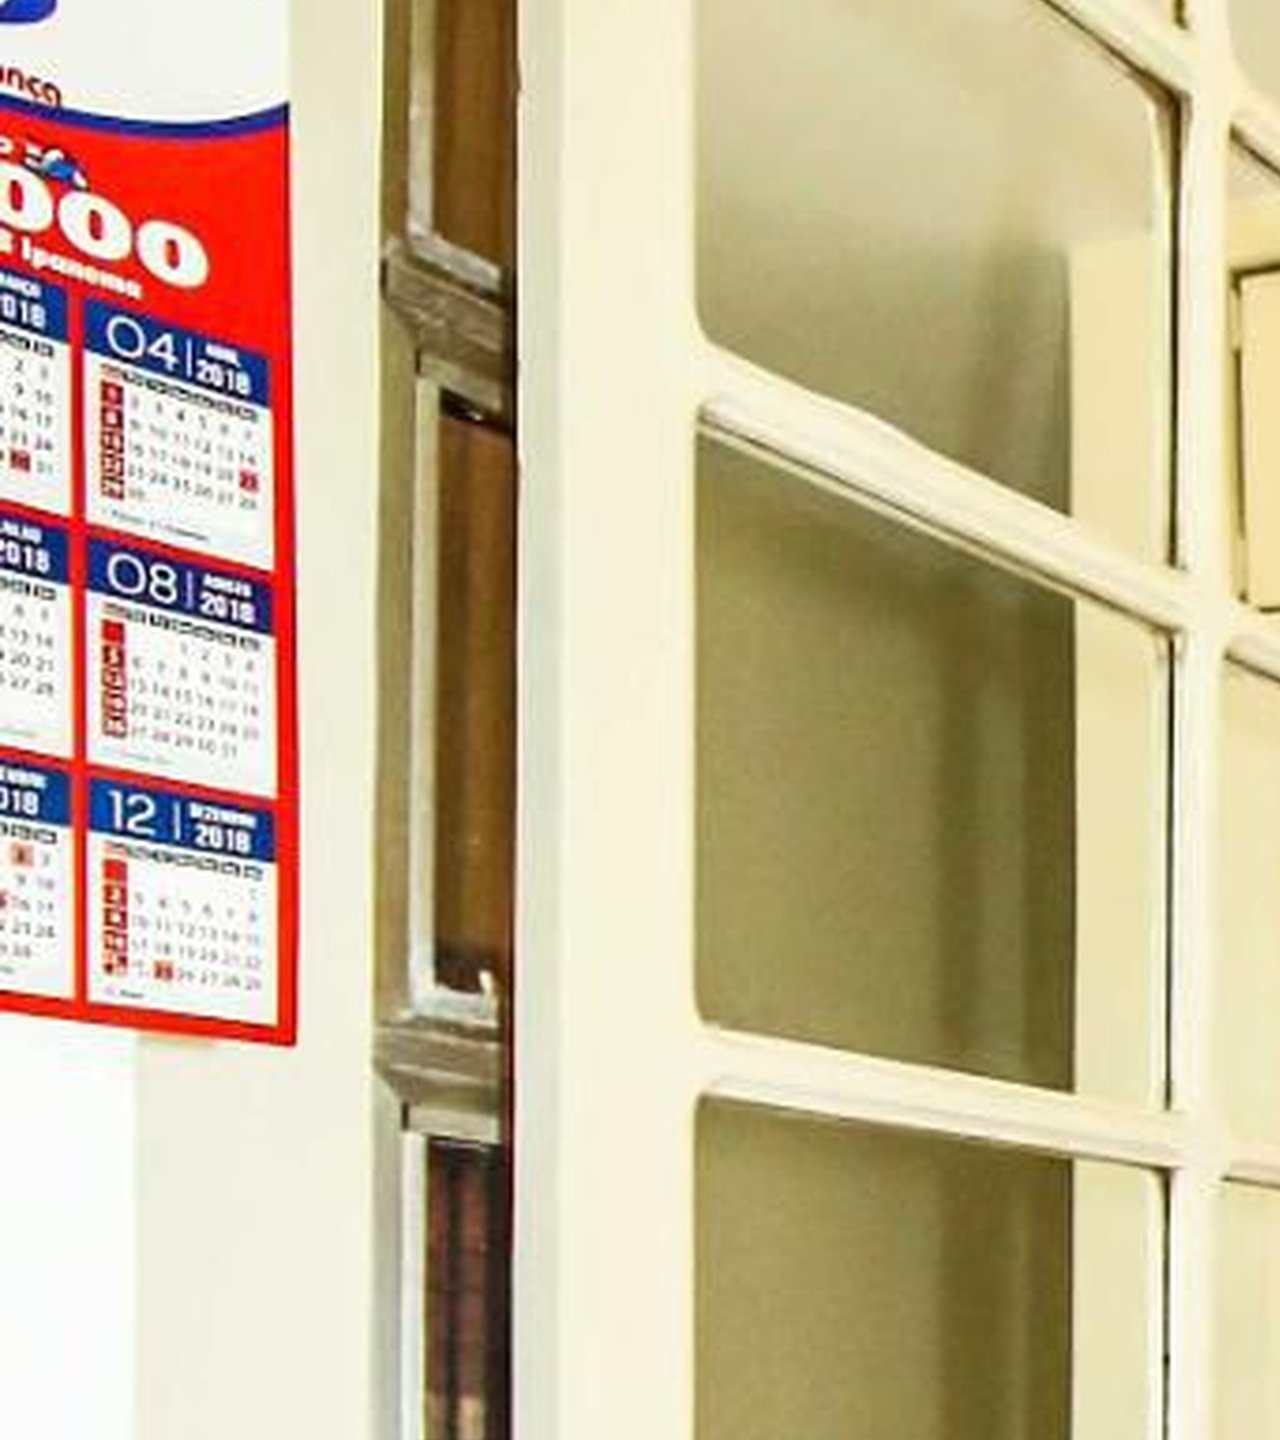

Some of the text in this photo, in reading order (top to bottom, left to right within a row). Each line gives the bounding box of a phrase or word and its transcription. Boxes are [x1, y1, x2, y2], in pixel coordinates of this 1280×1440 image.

[106, 316, 178, 370] 04
[196, 359, 251, 395] 2018
[106, 553, 178, 605] 08
[199, 591, 256, 624] 2018
[107, 789, 157, 836] 12
[194, 823, 250, 854] 2018
